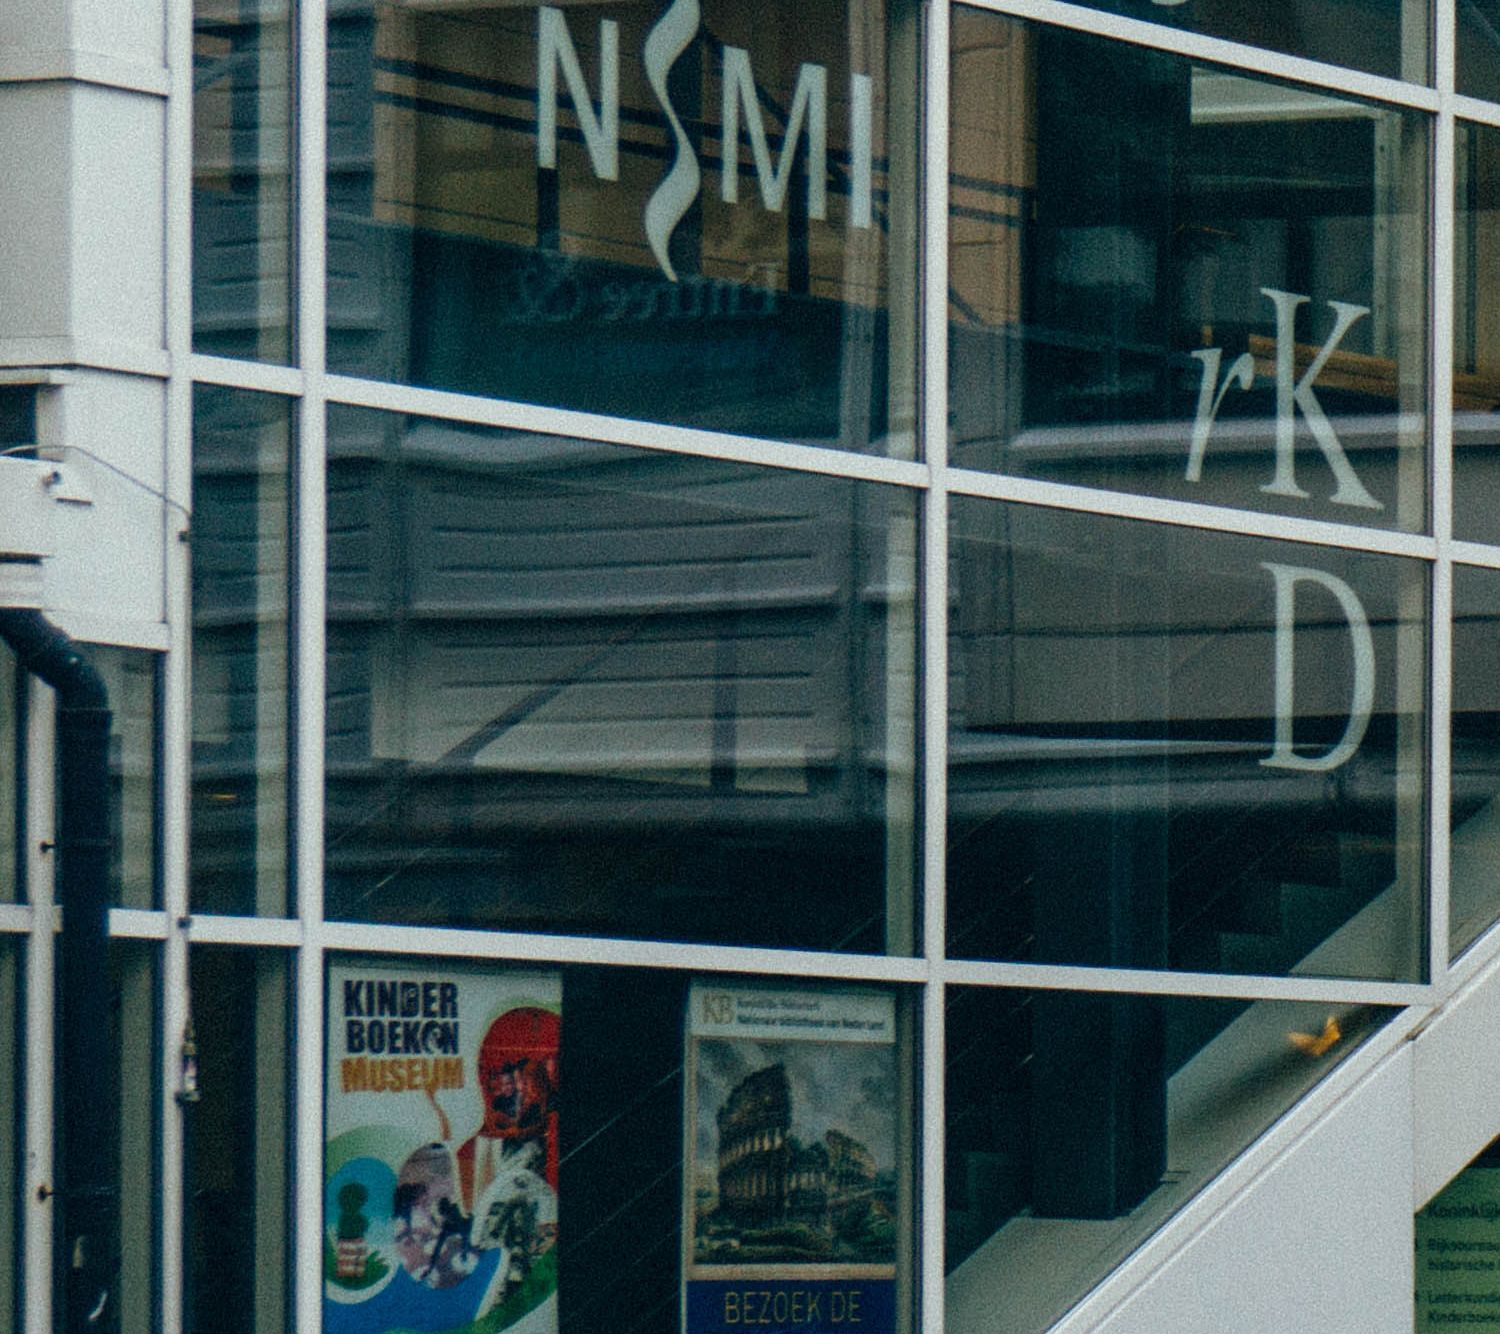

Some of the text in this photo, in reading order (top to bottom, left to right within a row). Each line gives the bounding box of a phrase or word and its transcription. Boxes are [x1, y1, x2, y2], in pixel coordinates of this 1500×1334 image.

[1258, 562, 1375, 771] D
[344, 980, 459, 1018] KINDER
[342, 1056, 464, 1093] MUSEUM
[724, 1290, 863, 1324] BEZOEK DE
